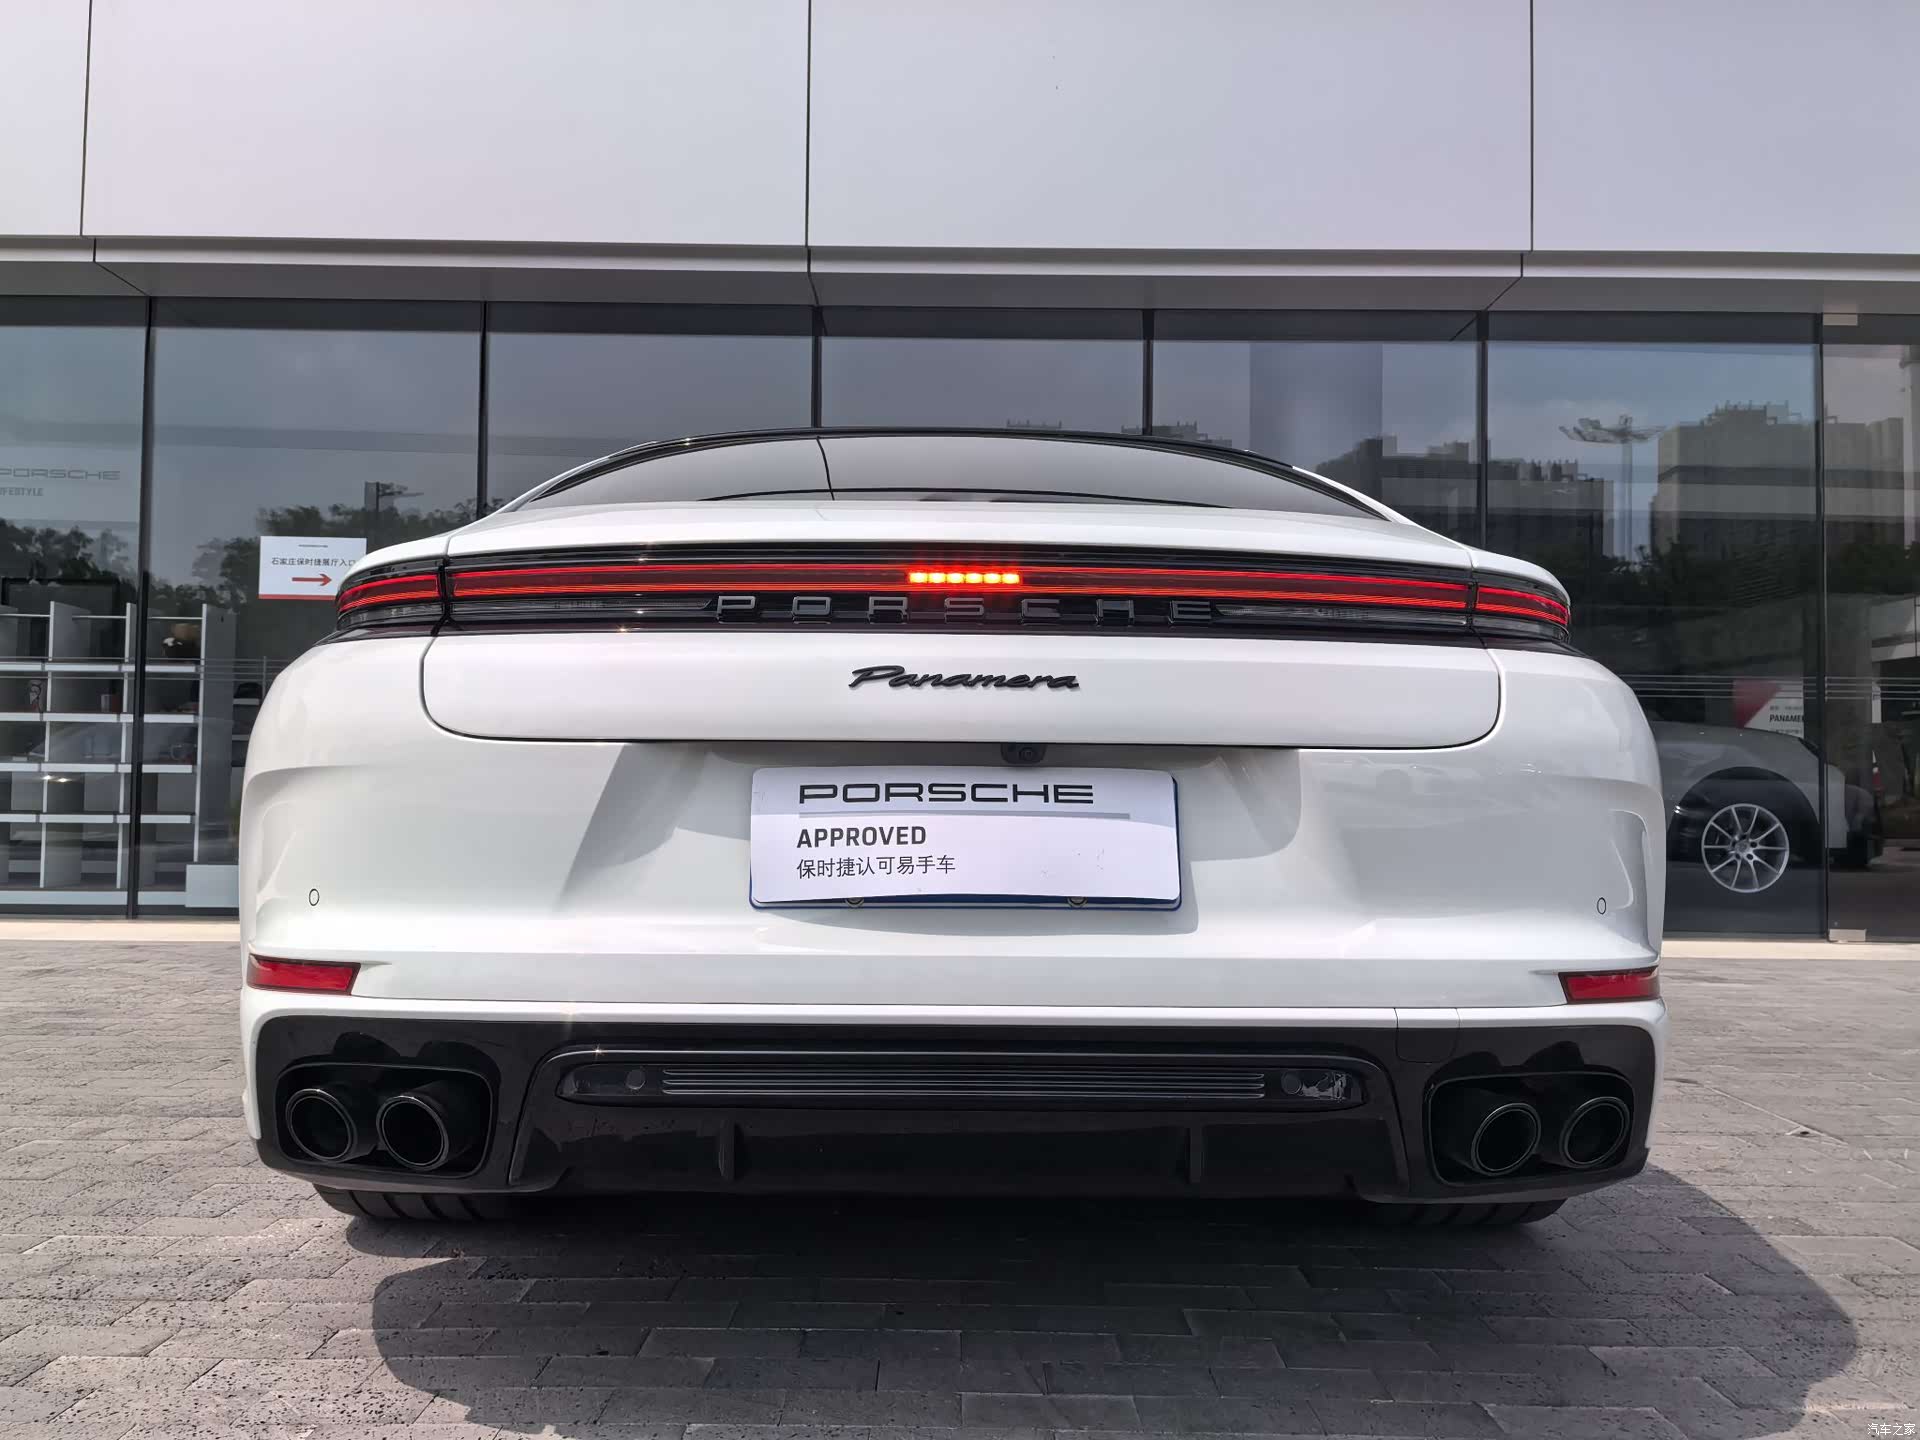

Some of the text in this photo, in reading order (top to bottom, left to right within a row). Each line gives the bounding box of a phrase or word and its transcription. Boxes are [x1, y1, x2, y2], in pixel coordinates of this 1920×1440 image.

[0, 468, 120, 480] PORSCHE
[716, 594, 1212, 626] PORSCHE
[848, 665, 1080, 690] Panamera
[799, 783, 1094, 804] PORSCHE
[796, 825, 927, 849] APPROVED
[796, 854, 956, 880] 保时捷认可易手车
